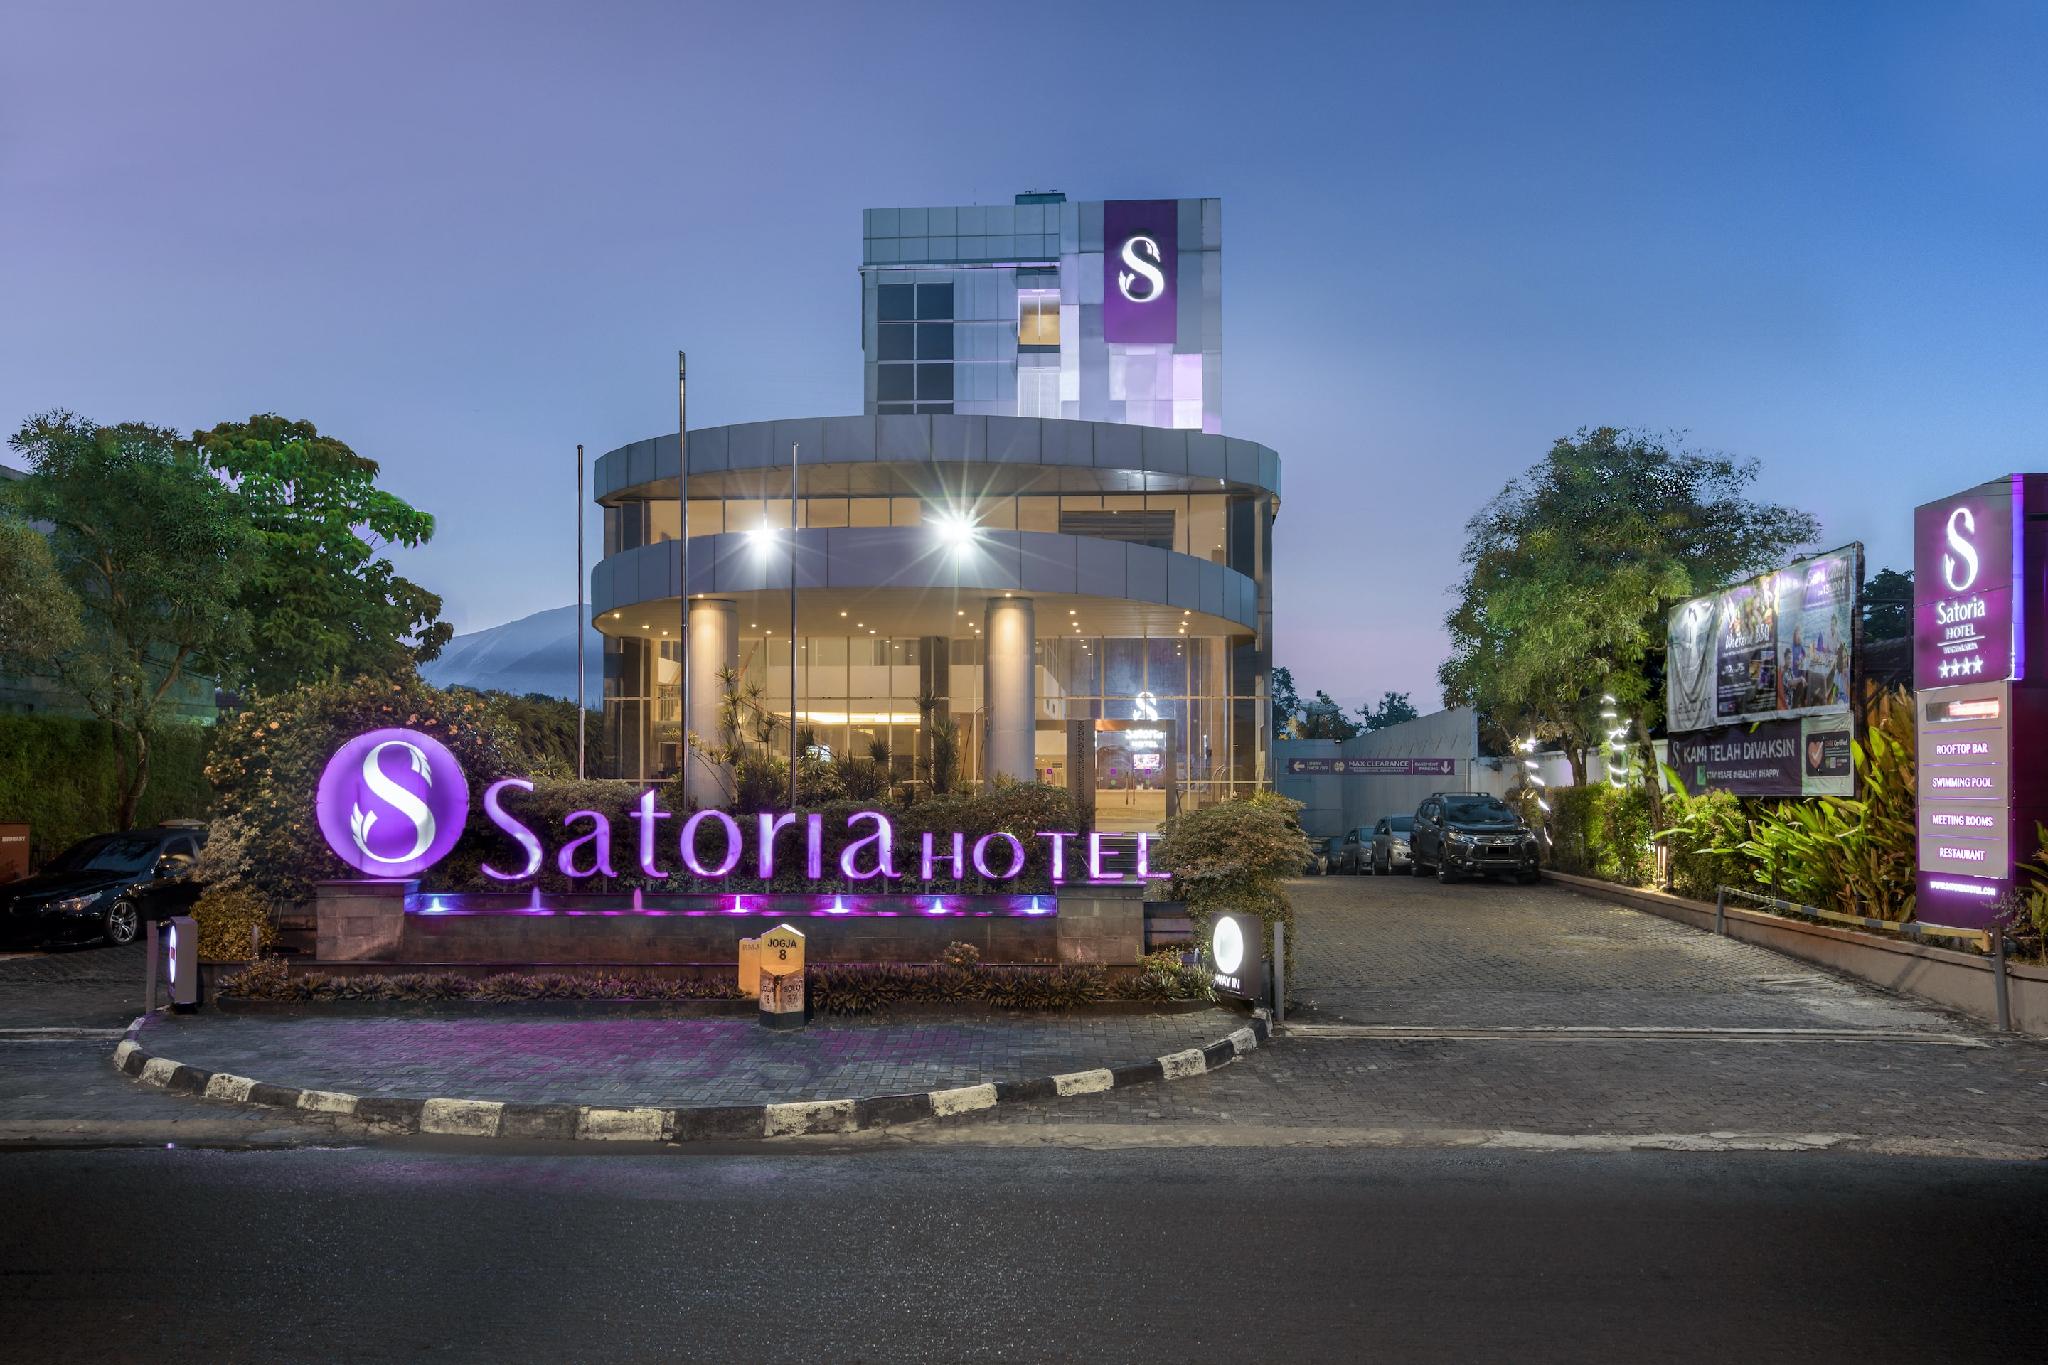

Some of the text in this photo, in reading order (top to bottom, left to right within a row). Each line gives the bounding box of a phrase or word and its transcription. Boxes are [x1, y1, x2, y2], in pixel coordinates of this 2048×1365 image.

[1118, 235, 1165, 303] S
[1944, 507, 1979, 591] S
[1936, 595, 1986, 625] Satoria
[1946, 623, 1976, 640] HOTEL
[1683, 745, 1708, 763] KAMI
[1708, 743, 1741, 762] TELAH
[1743, 739, 1795, 760] DIVAKSIN
[1936, 742, 1988, 755] ROOFTOP BAR
[1932, 777, 1993, 788] SWIMMING POOL
[350, 740, 436, 863] S
[1932, 814, 1994, 827] MEETING ROOMS
[481, 778, 1172, 881] Satoria HOTEL
[1940, 847, 1985, 861] RESTAURANT
[767, 938, 797, 949] JOGJA
[779, 949, 787, 961] 8
[1231, 976, 1240, 990] IN
